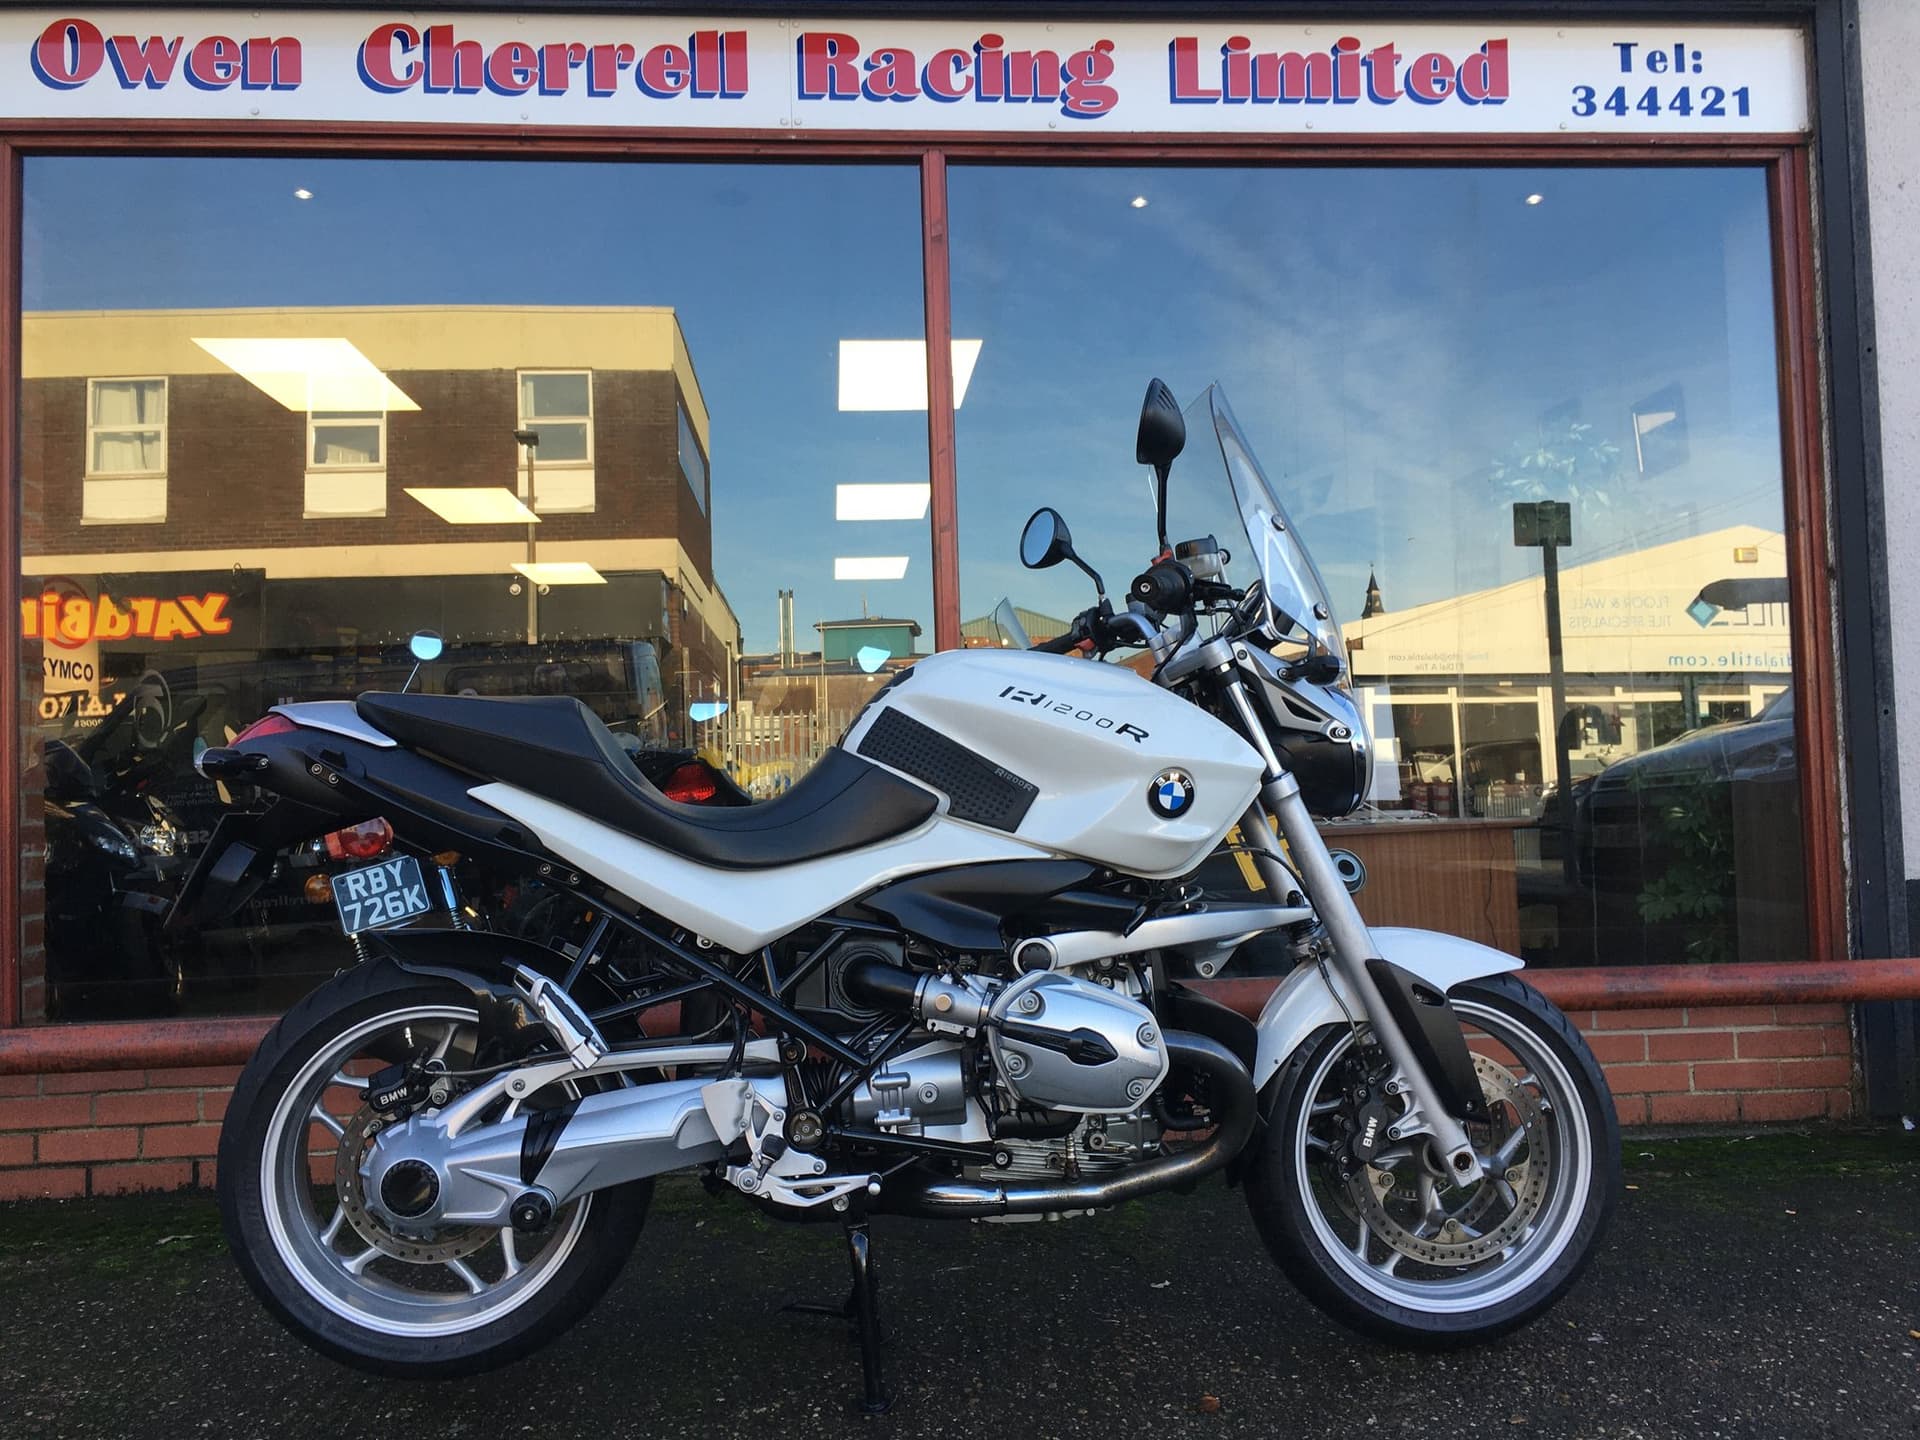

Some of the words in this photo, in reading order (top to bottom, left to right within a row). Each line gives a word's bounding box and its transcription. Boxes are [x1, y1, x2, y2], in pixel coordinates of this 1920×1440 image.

[31, 17, 302, 91] Owen
[357, 23, 748, 99] Cherrell
[797, 32, 1119, 119] Racing
[1170, 36, 1509, 104] Limited
[1612, 42, 1703, 74] Tel:
[1571, 85, 1751, 117] 344421
[1155, 772, 1192, 789] BMW
[345, 860, 403, 900] RBY
[343, 884, 426, 930] 726K
[380, 1087, 408, 1105] BMW
[1362, 1116, 1379, 1148] BMW
